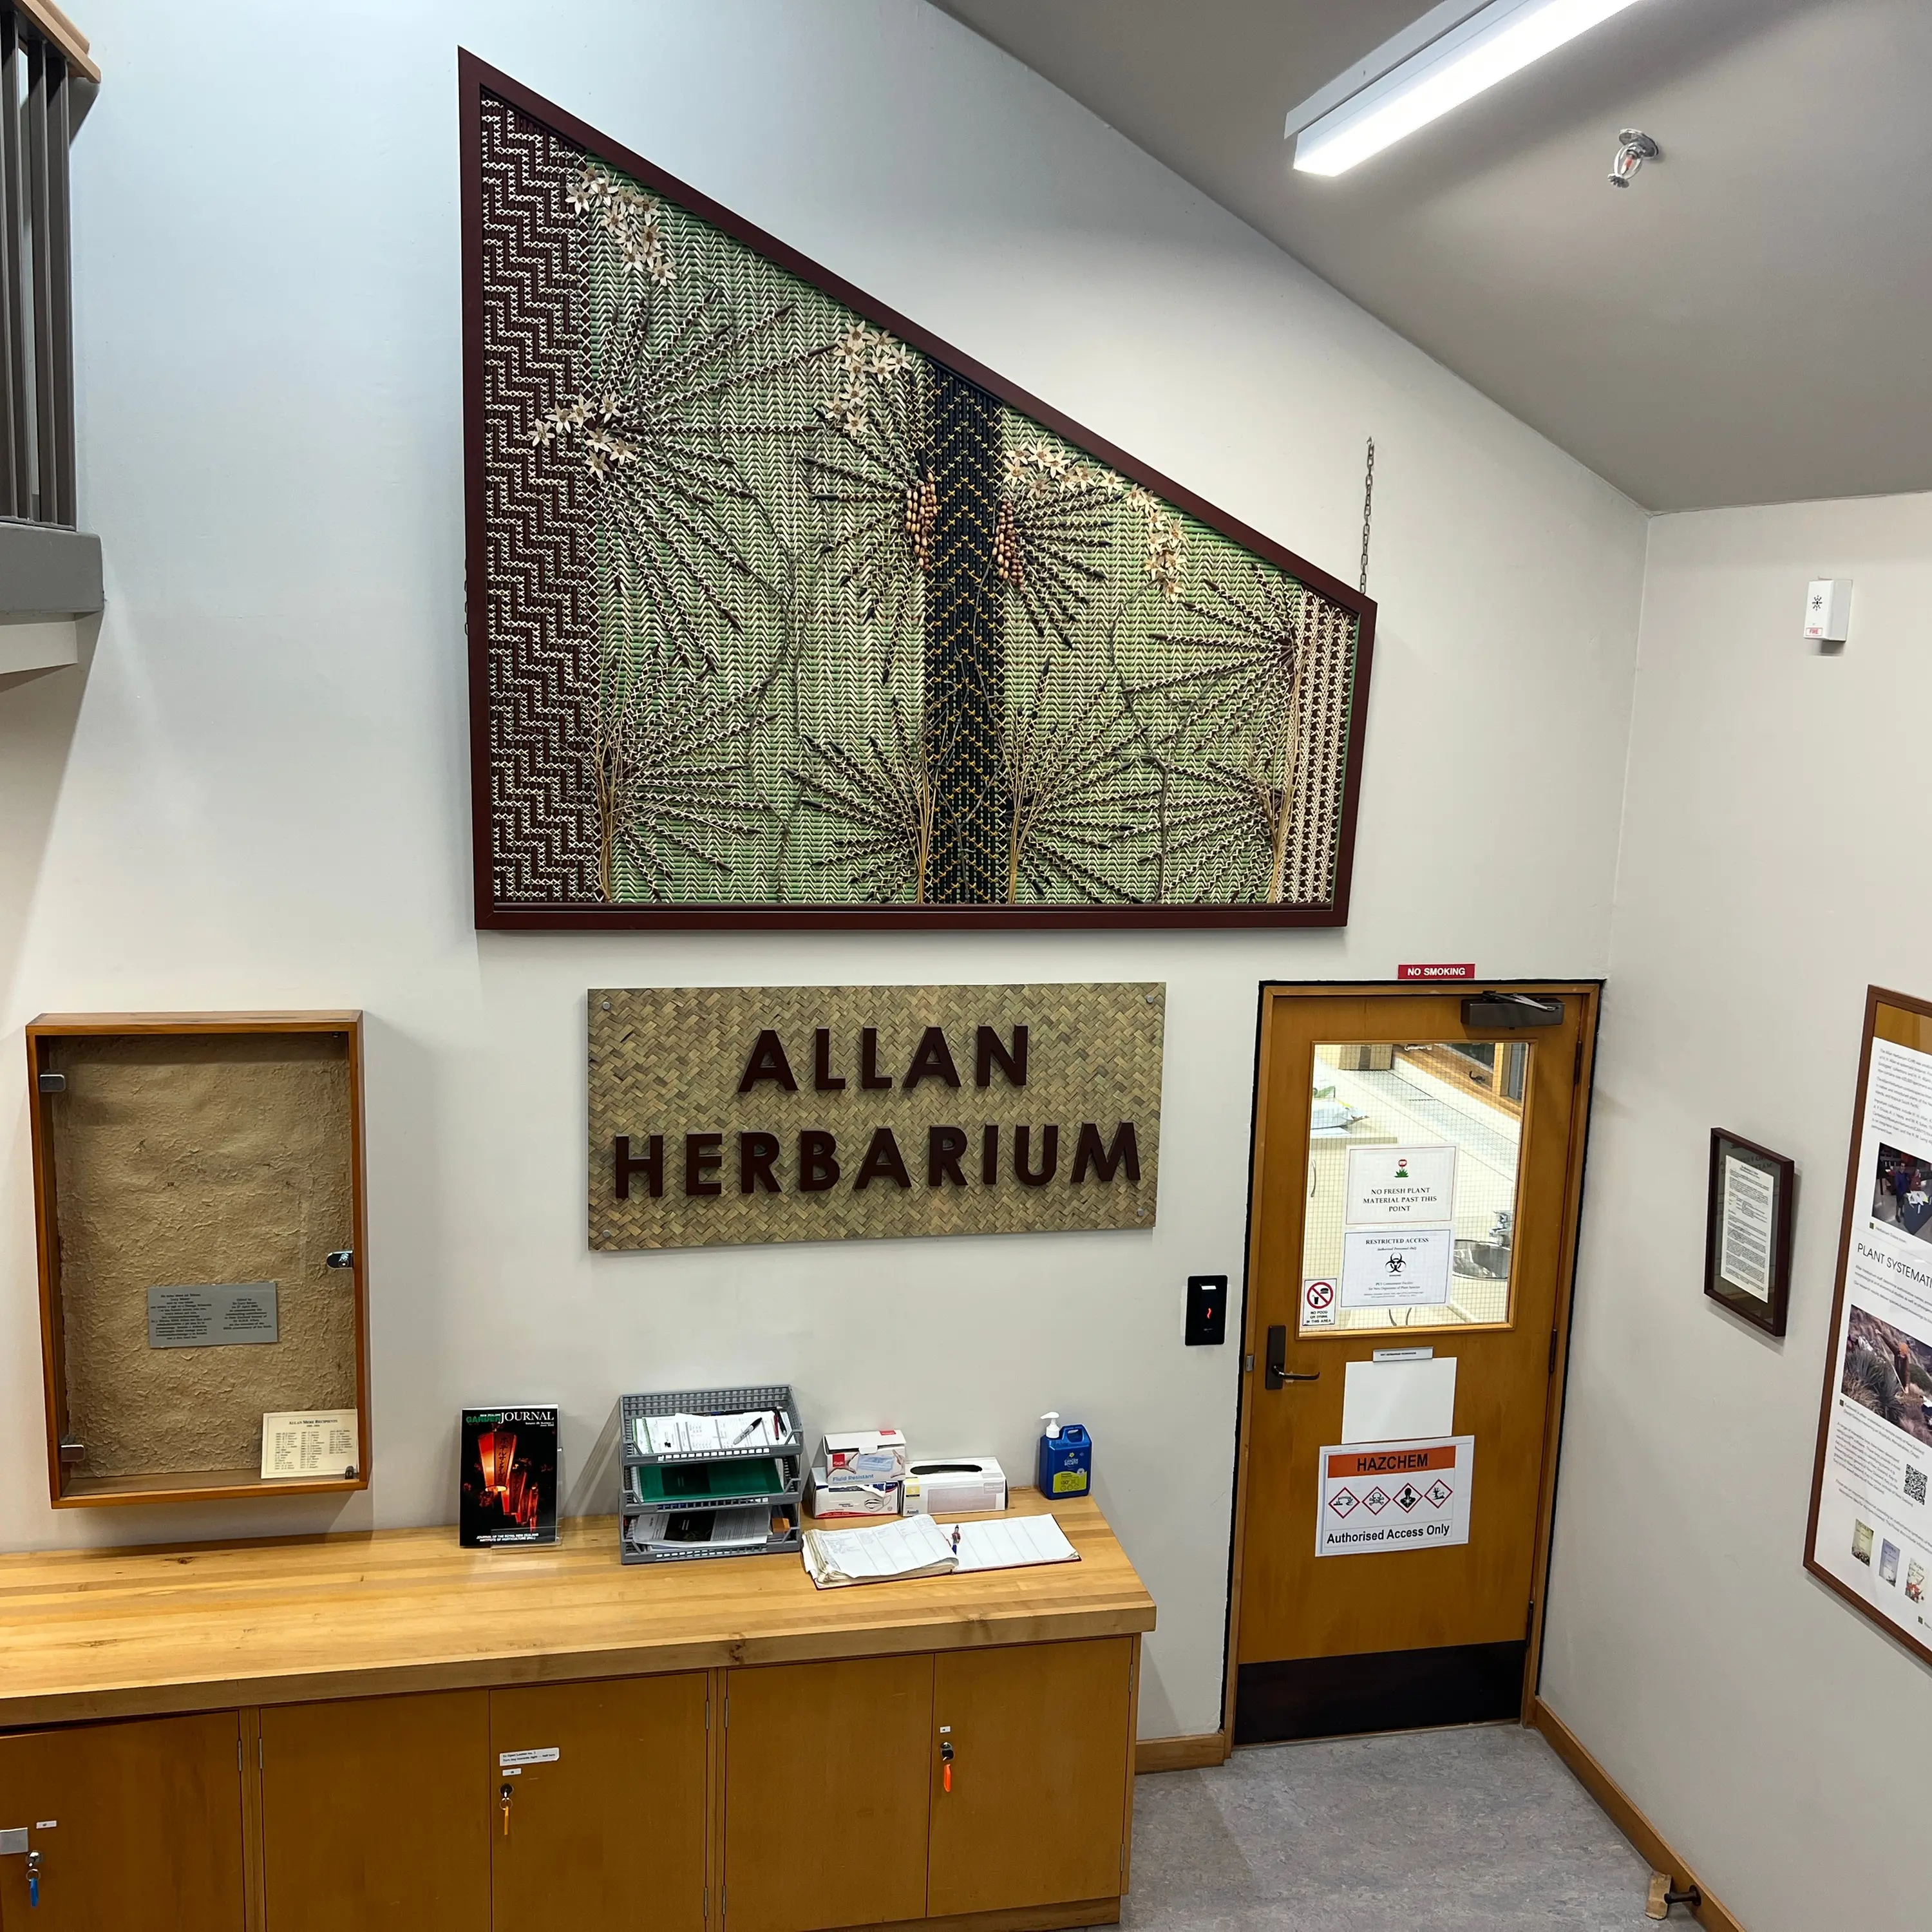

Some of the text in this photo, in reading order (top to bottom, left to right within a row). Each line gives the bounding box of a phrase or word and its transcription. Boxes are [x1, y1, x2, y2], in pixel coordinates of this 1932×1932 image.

[1423, 967, 1466, 976] SMOKING
[737, 1023, 1028, 1092] ALLAN
[614, 1121, 1141, 1198] HERBARIUM
[1857, 1243, 1885, 1264] PLANT
[498, 1412, 554, 1424] JOURNAL
[1357, 1453, 1428, 1472] HAZCHEM
[1327, 1523, 1450, 1544] Authorised Access Only
